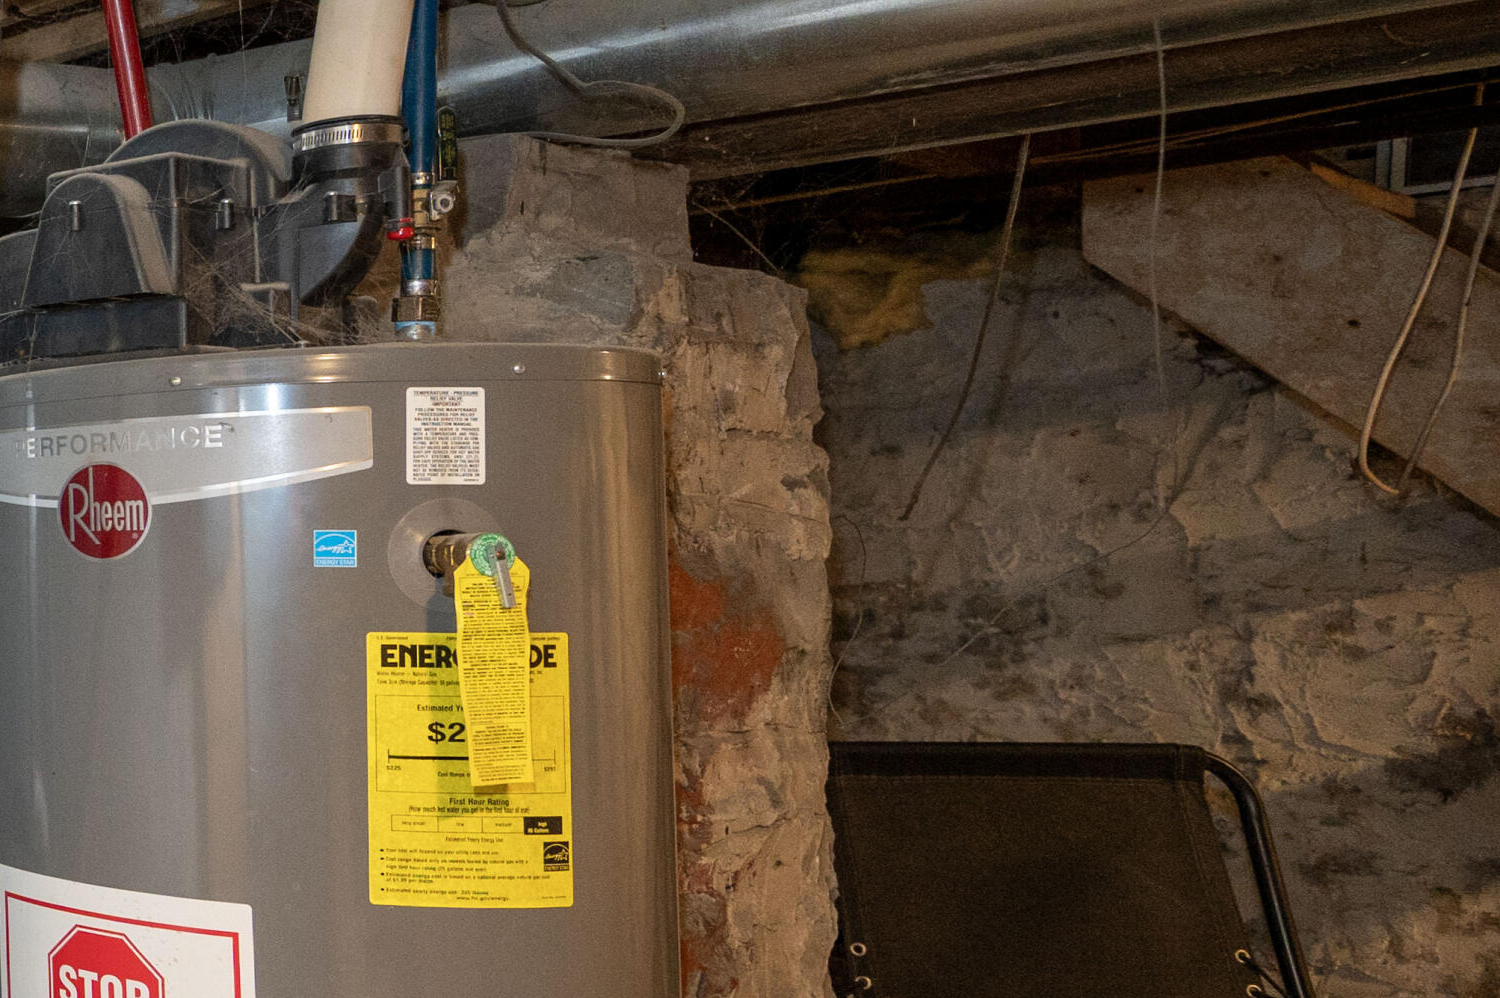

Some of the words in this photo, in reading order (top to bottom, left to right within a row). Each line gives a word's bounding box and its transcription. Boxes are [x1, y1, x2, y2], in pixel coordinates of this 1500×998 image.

[68, 466, 145, 545] Rheem
[417, 704, 453, 712] Estimated
[427, 721, 466, 744] $2
[449, 798, 467, 806] First
[468, 798, 486, 806] Hour
[487, 798, 510, 807] Rating
